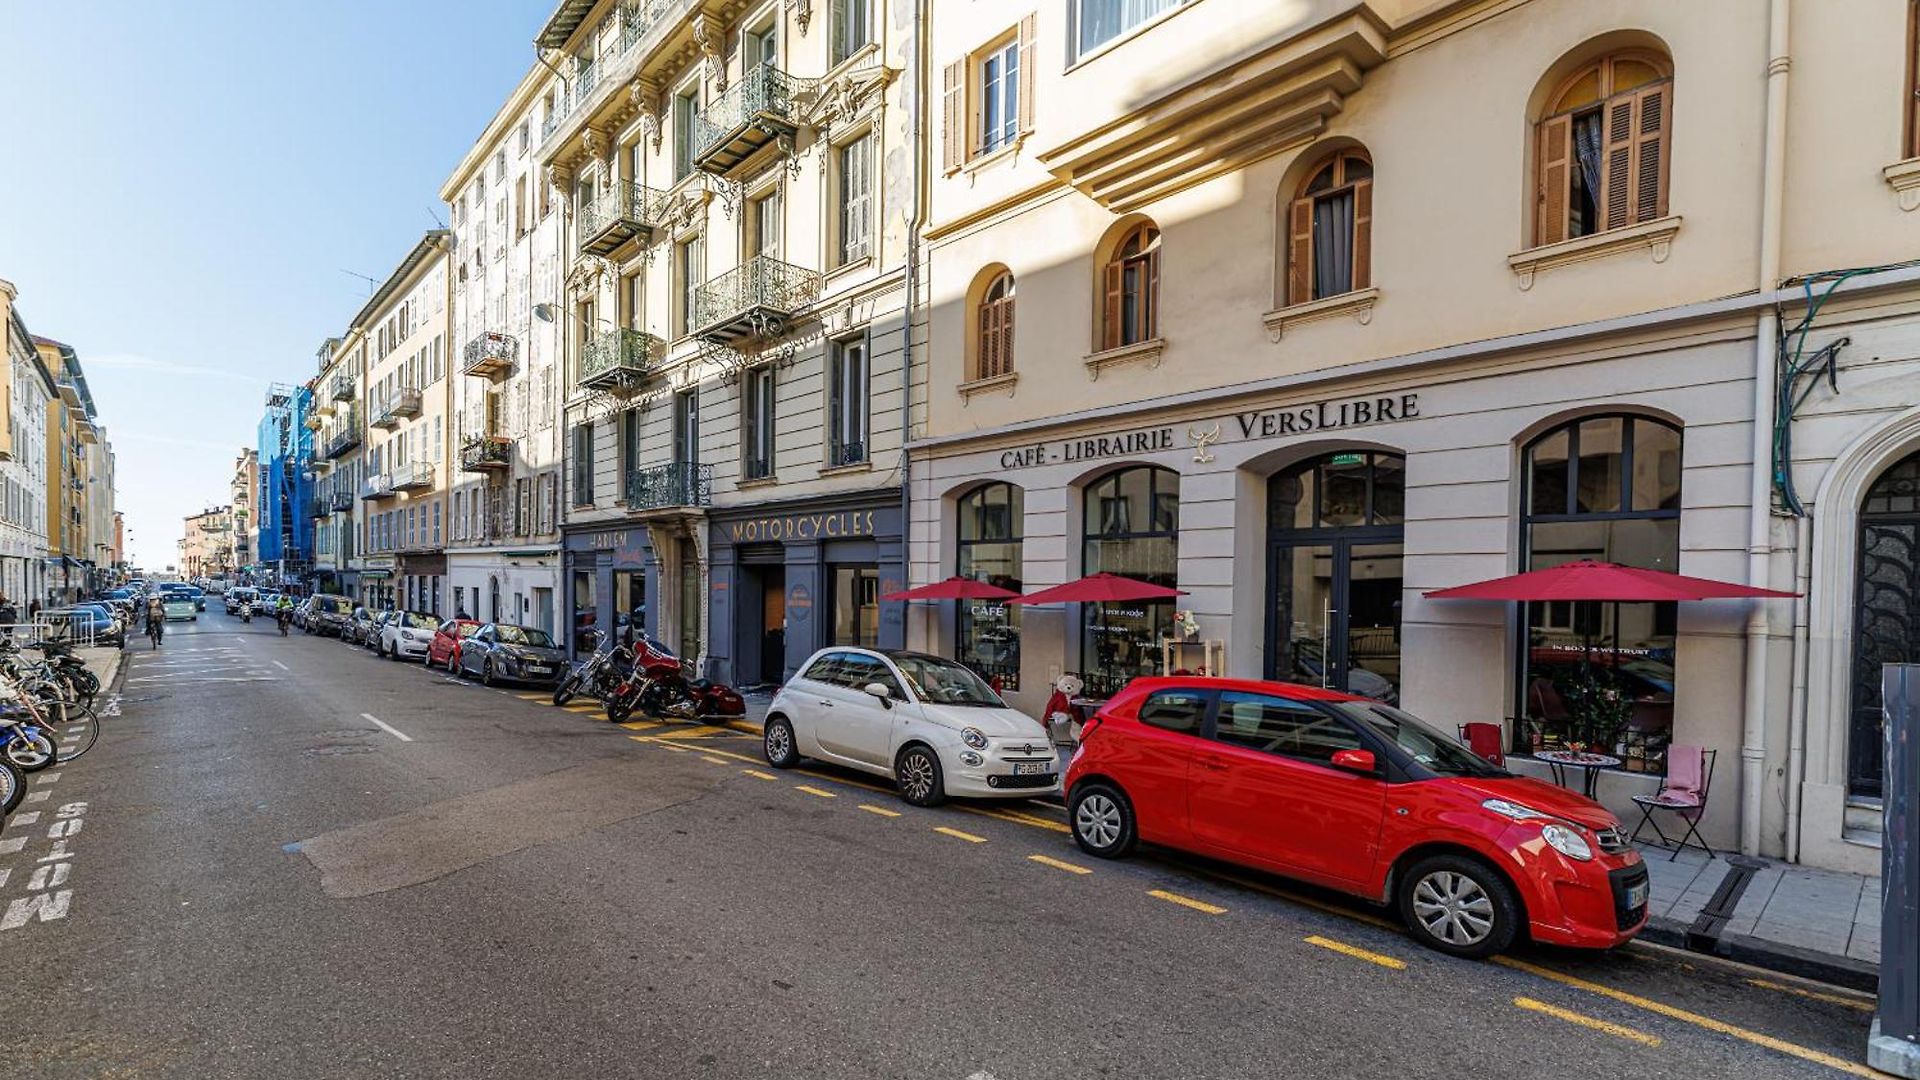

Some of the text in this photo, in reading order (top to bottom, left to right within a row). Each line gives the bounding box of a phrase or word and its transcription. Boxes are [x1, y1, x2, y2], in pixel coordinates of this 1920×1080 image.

[1000, 443, 1046, 469] CAFÉ
[1063, 428, 1174, 462] LIBRAIRIE
[732, 511, 875, 542] MOTORCYCLES
[971, 602, 1005, 617] CAFÉ
[1618, 648, 1650, 656] TRUST
